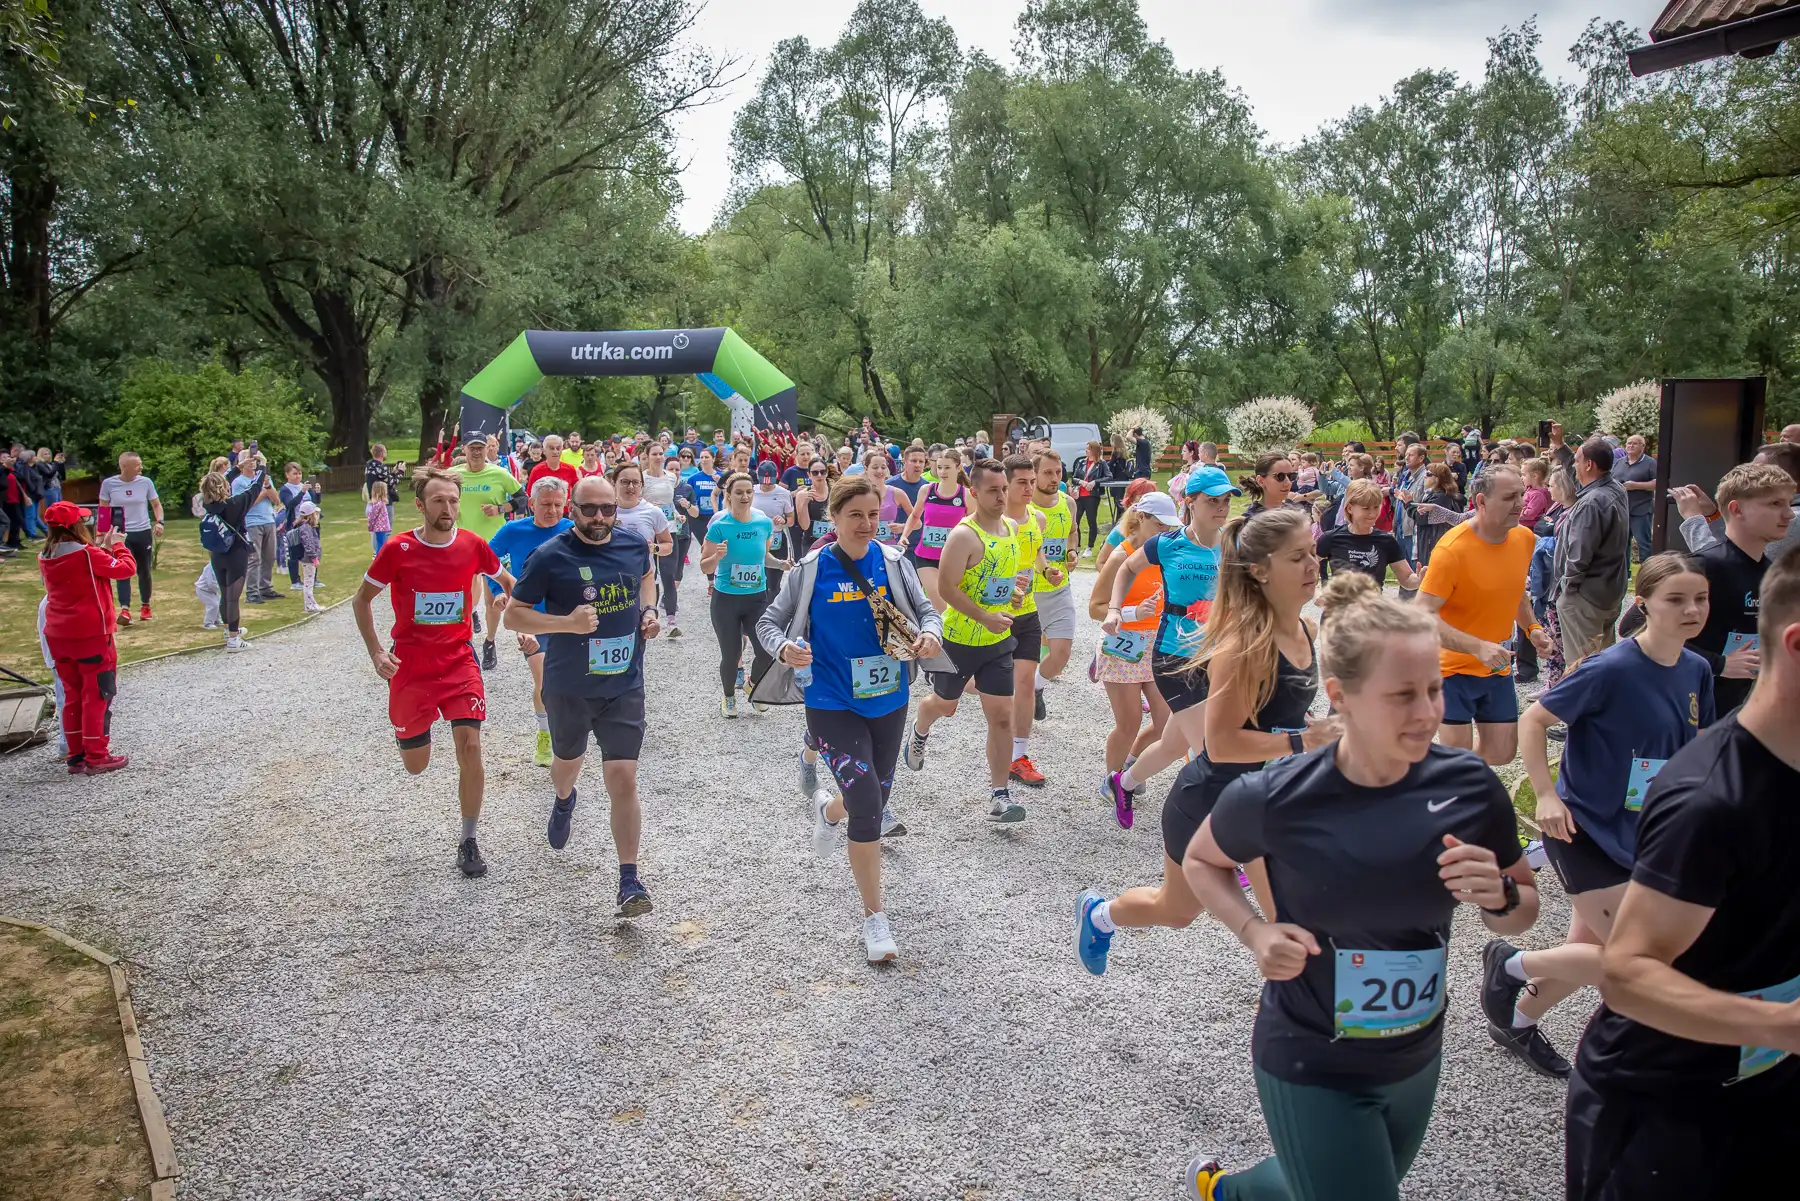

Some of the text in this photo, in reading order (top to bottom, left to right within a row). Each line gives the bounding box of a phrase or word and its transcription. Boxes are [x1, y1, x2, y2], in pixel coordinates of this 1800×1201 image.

[571, 341, 673, 360] utrka.com
[461, 484, 481, 492] nicef
[928, 532, 947, 542] 134
[1043, 545, 1062, 556] 159
[1177, 562, 1203, 571] ŠKOLA
[737, 571, 757, 581] 106
[838, 581, 854, 593] WE
[994, 585, 1009, 598] 59
[424, 602, 455, 616] 207
[1114, 636, 1134, 654] 72
[600, 646, 629, 664] 180
[869, 666, 890, 686] 52
[1361, 972, 1439, 1012] 204
